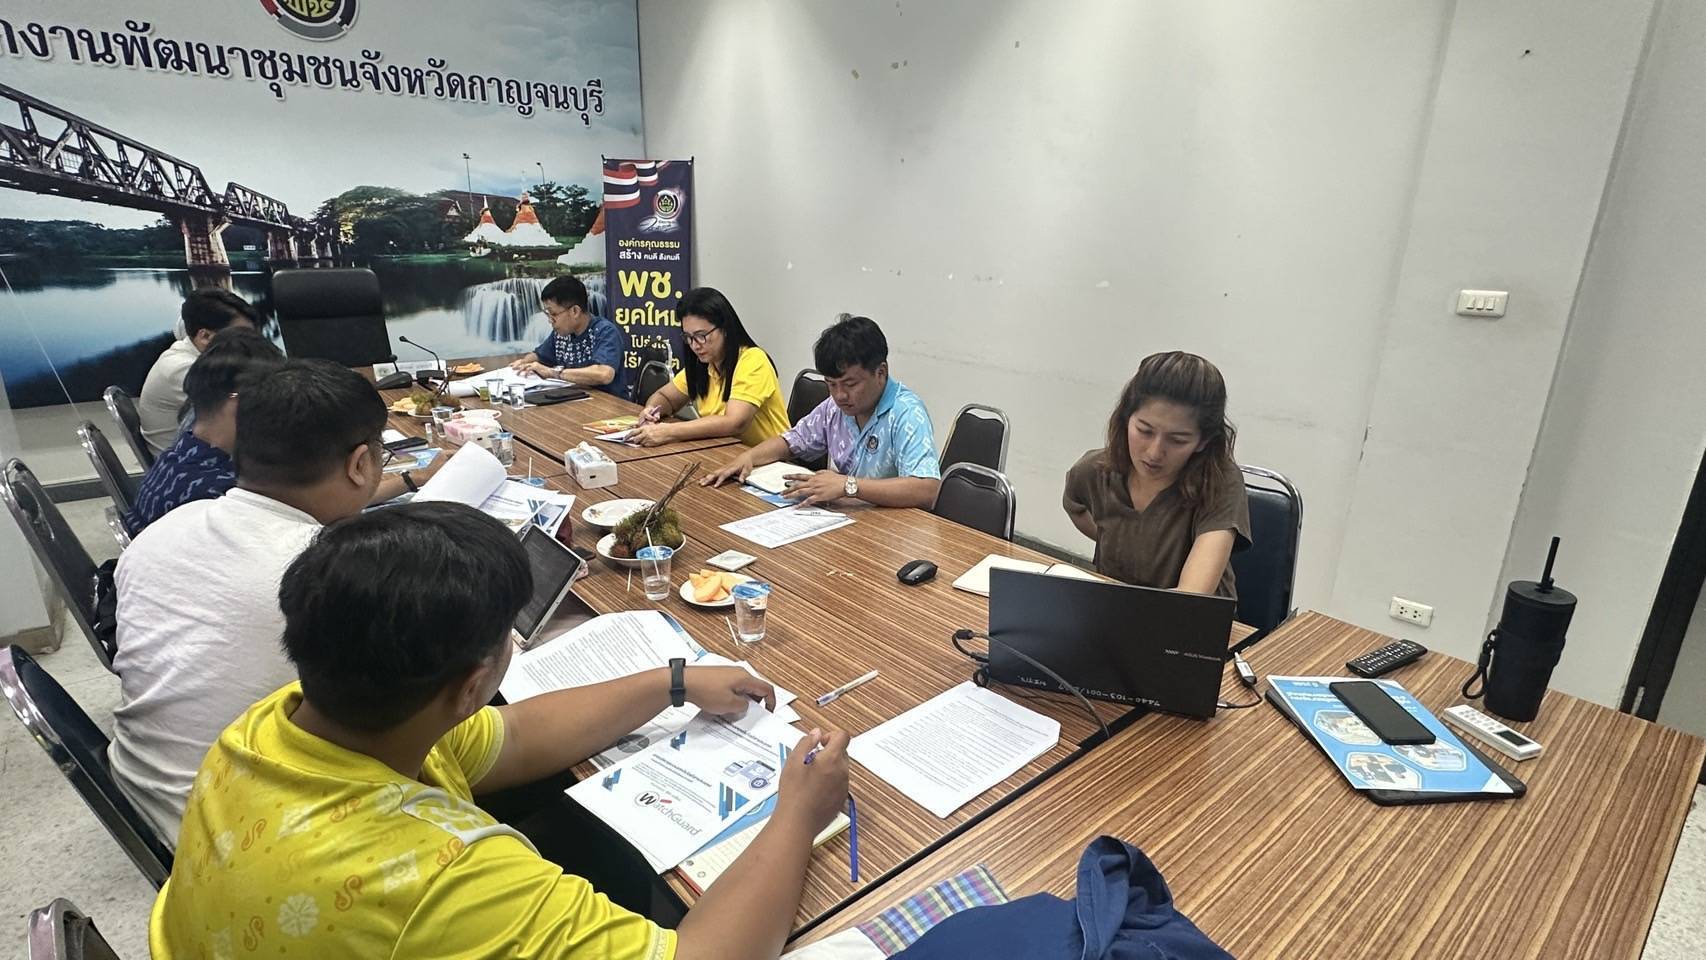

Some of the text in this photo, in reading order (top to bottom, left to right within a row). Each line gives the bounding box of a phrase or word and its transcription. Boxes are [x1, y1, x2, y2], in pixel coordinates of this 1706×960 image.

[618, 237, 680, 251] องค์กรคุณธรรม
[619, 249, 642, 260] สร้าง
[618, 269, 683, 299] พช.
[615, 301, 682, 333] ยุคใหม
[635, 791, 702, 836] WatchGuard
